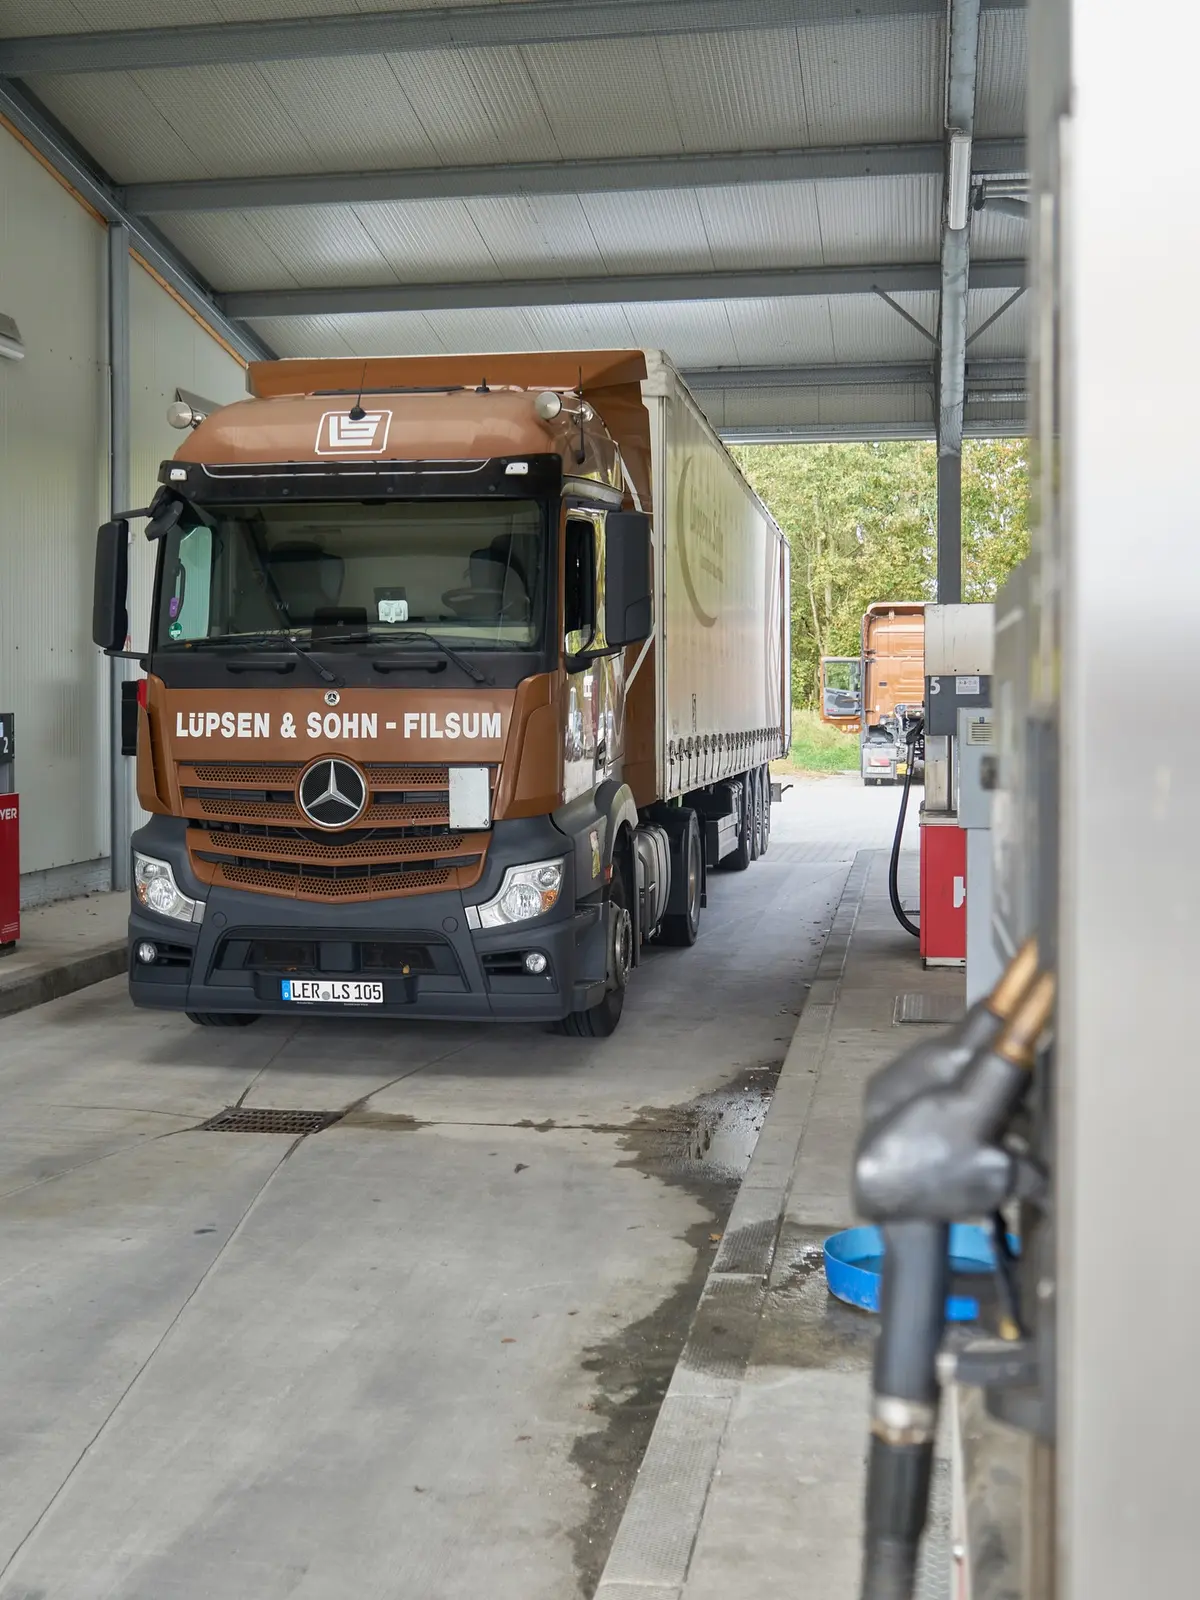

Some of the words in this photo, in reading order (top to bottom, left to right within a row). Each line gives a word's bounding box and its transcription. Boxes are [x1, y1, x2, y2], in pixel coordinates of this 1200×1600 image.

[930, 677, 941, 695] 5
[176, 711, 270, 738] LÜPSEN
[280, 712, 297, 739] &
[306, 711, 378, 739] SOHN
[404, 711, 502, 739] FILSUM
[3, 736, 9, 753] 2
[292, 982, 320, 999] LER
[332, 983, 350, 1000] LS
[354, 984, 381, 1000] 105
